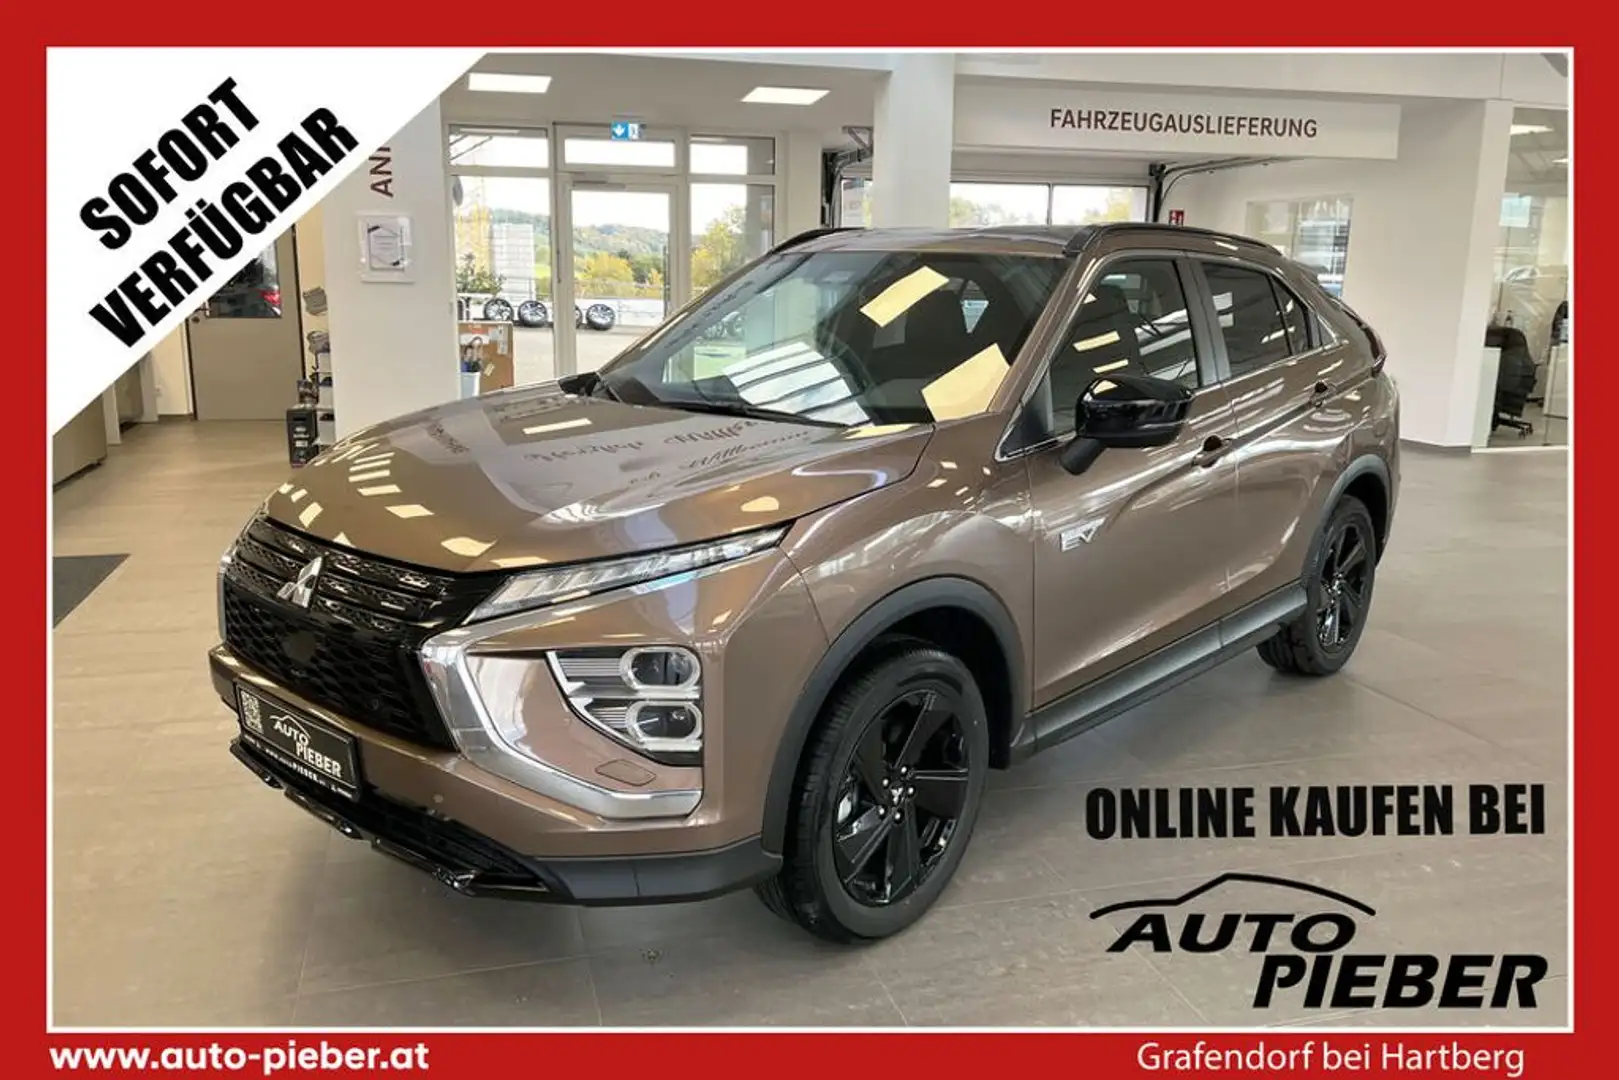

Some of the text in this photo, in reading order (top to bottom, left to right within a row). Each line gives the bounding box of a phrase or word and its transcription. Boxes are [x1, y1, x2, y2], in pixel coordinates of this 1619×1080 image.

[1050, 108, 1318, 139] FAHRZEUGAUSLIEFERUNG
[274, 720, 309, 747] AUTO
[295, 741, 342, 778] PIEBER
